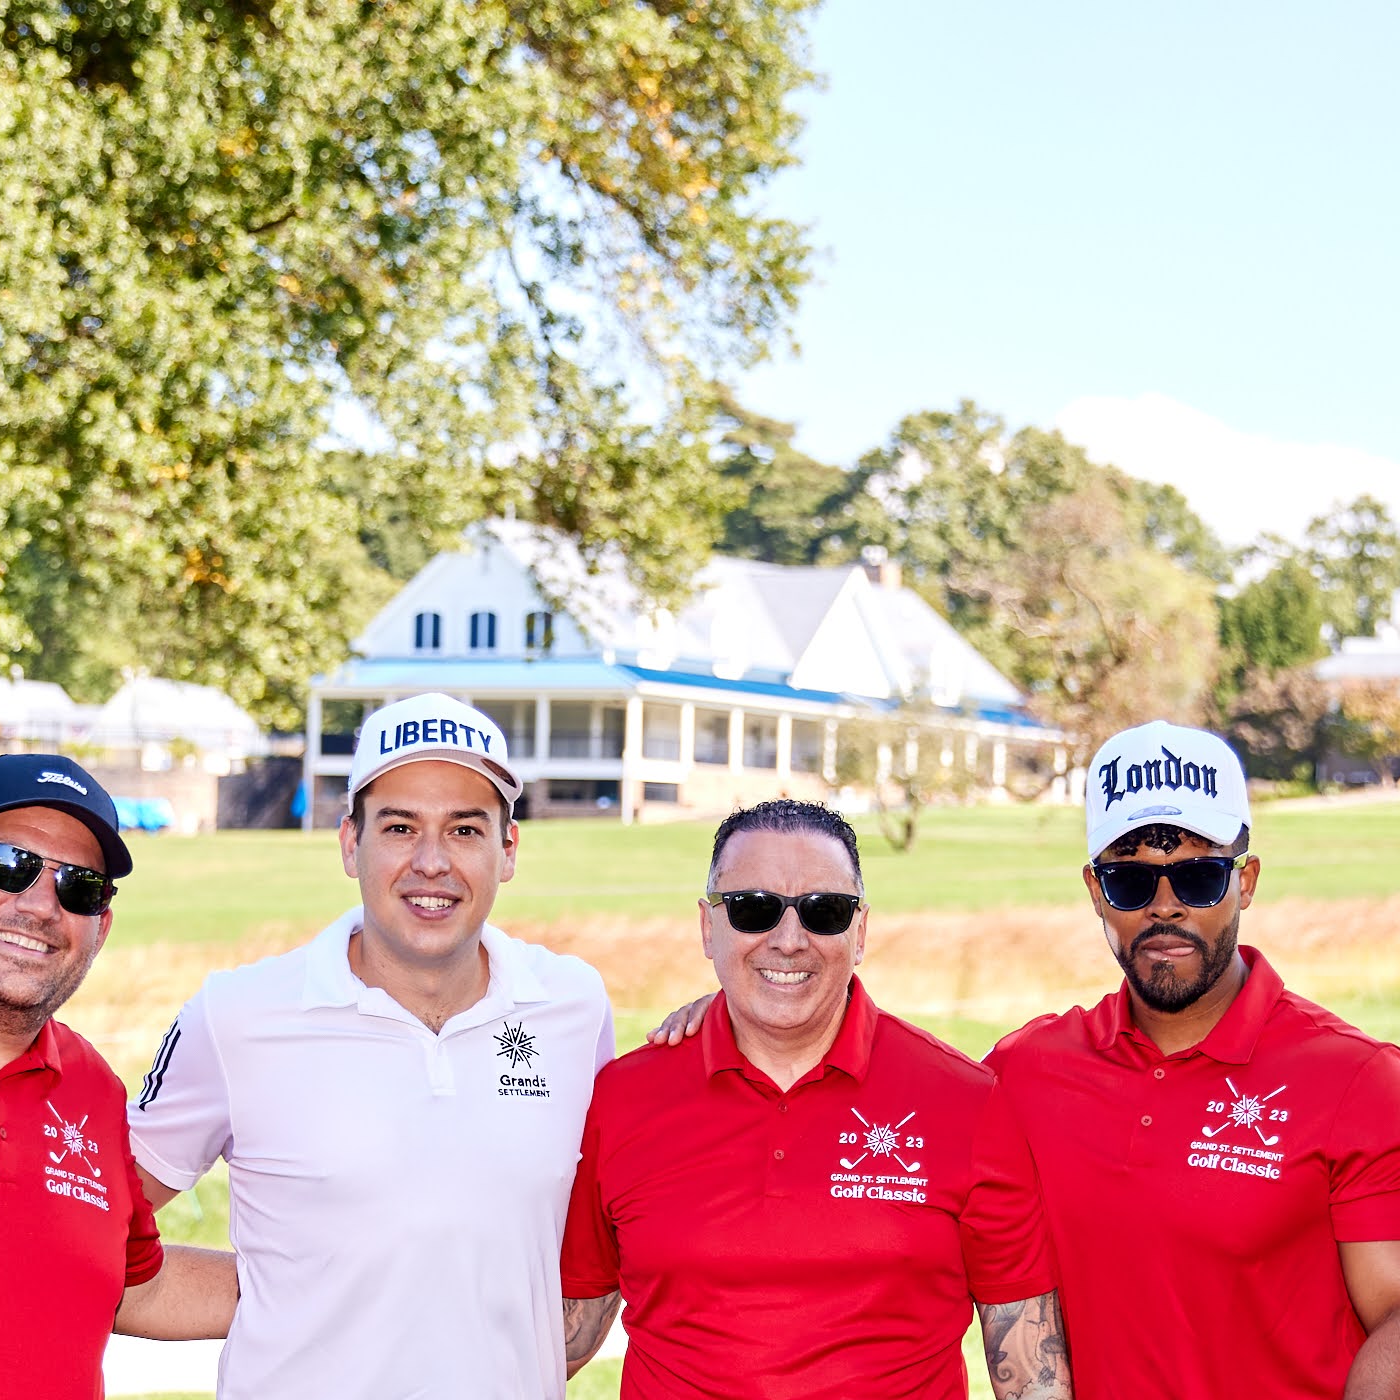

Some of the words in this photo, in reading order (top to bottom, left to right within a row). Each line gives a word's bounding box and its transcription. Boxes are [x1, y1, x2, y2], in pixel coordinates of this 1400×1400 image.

[380, 718, 492, 755] LIBERTY
[1099, 745, 1218, 812] London
[497, 1088, 551, 1098] SETTLEMENT
[1206, 1101, 1224, 1113] 20
[1269, 1109, 1288, 1122] 23
[44, 1124, 58, 1138] 20
[87, 1140, 99, 1154] 23
[839, 1132, 857, 1144] 20
[905, 1136, 924, 1149] 23
[1190, 1141, 1218, 1151] GRAND
[1219, 1144, 1230, 1153] ST.
[1232, 1146, 1284, 1162] SETTLEMENT
[1187, 1153, 1220, 1169] Golf
[1220, 1157, 1280, 1179] Classic
[45, 1166, 67, 1179] GRAND
[68, 1172, 77, 1181] ST.
[77, 1175, 107, 1194] SETTLEMENT
[830, 1173, 860, 1182] GRAND
[862, 1175, 874, 1184] ST.
[875, 1176, 928, 1187] SETTLEMENT
[46, 1179, 72, 1197] Golf
[72, 1186, 110, 1212] Classic
[830, 1185, 865, 1198] Golf
[866, 1187, 926, 1203] Classic
